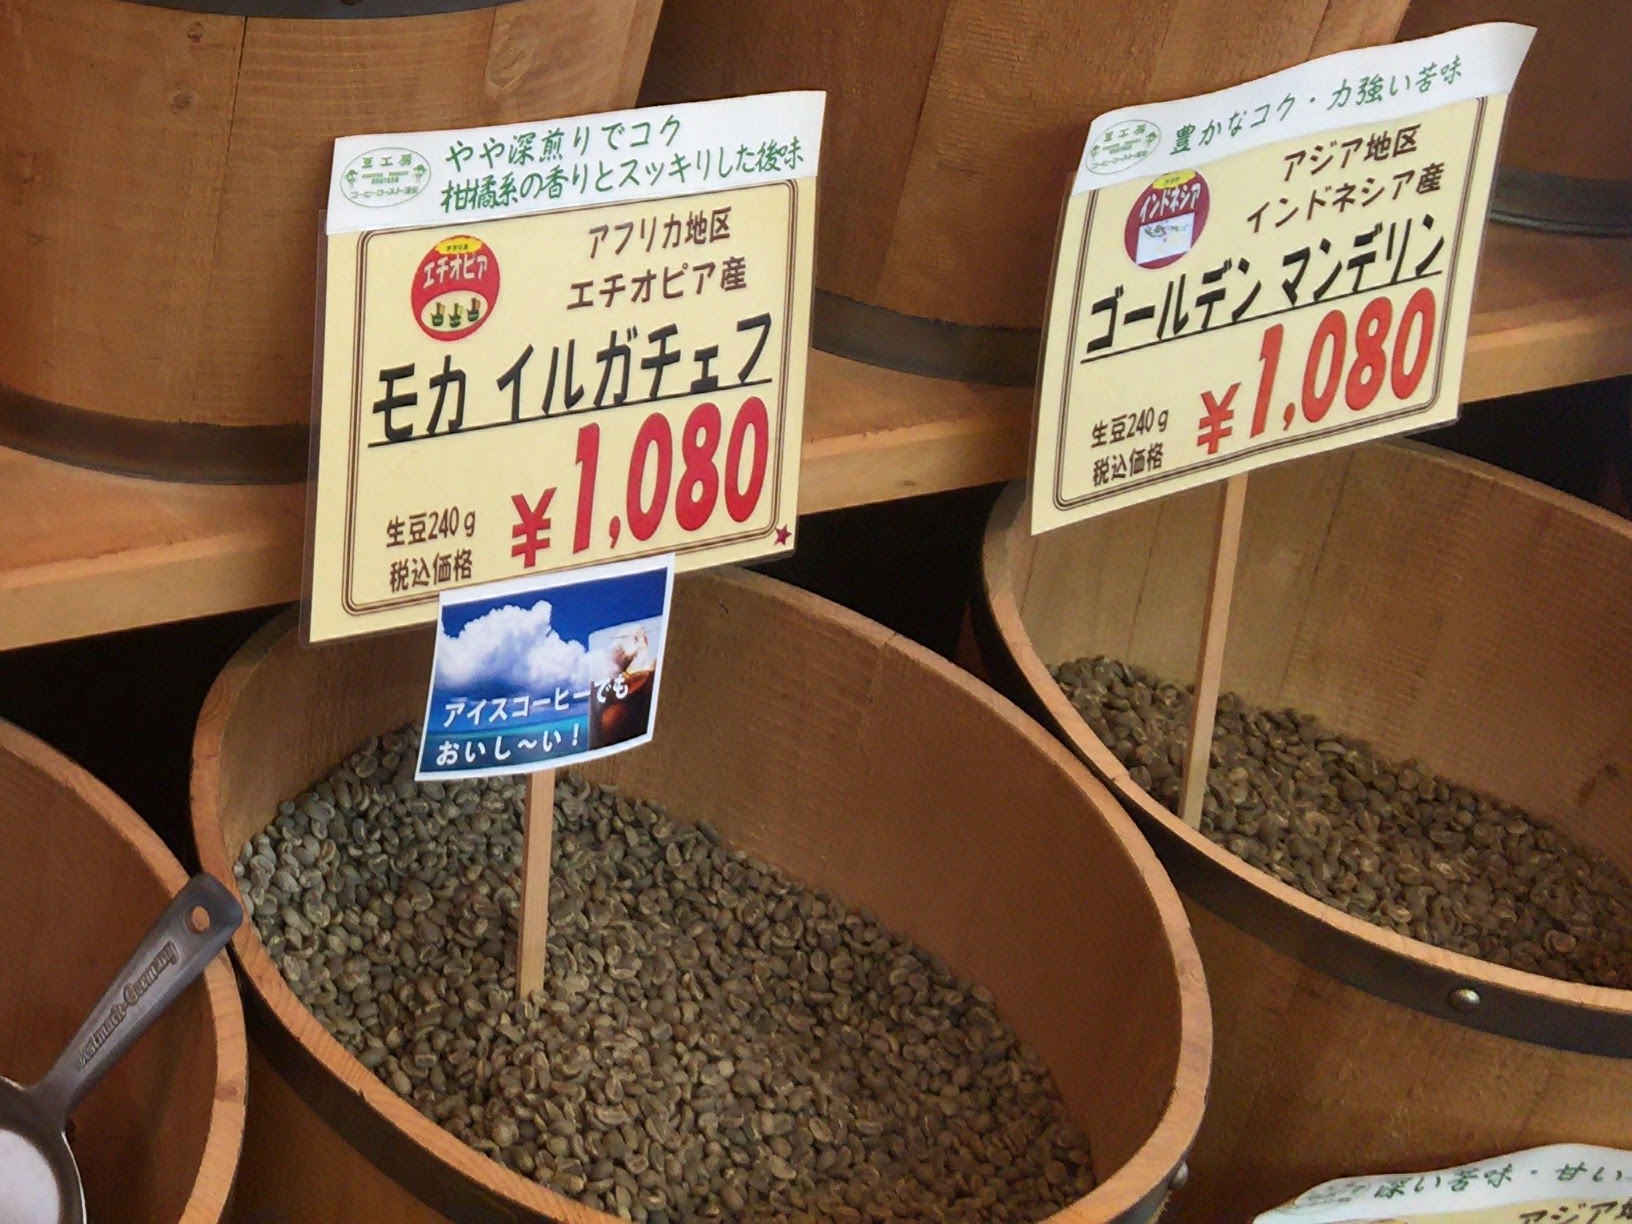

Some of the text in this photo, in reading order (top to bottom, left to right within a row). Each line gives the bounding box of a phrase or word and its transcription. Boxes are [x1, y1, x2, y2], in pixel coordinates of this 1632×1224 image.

[446, 114, 684, 173] やや深煎りでコク
[1284, 123, 1422, 182] アジア地区
[440, 136, 804, 213] 柑橘系の香りとスッキリした後味
[1140, 183, 1201, 223] インドネシア
[1246, 162, 1445, 233] インドネシア産
[588, 206, 733, 259] アフリカ地区
[423, 254, 488, 289] エチオピア
[567, 256, 748, 311] エチオピア産
[372, 312, 772, 444] モカ イルガチェフ
[1196, 287, 1436, 455] ¥1,080
[510, 395, 769, 568] ¥1,080
[1093, 442, 1164, 487] 税込価格
[389, 549, 473, 594] 税込価格
[443, 674, 629, 728] アイスコーヒーでも
